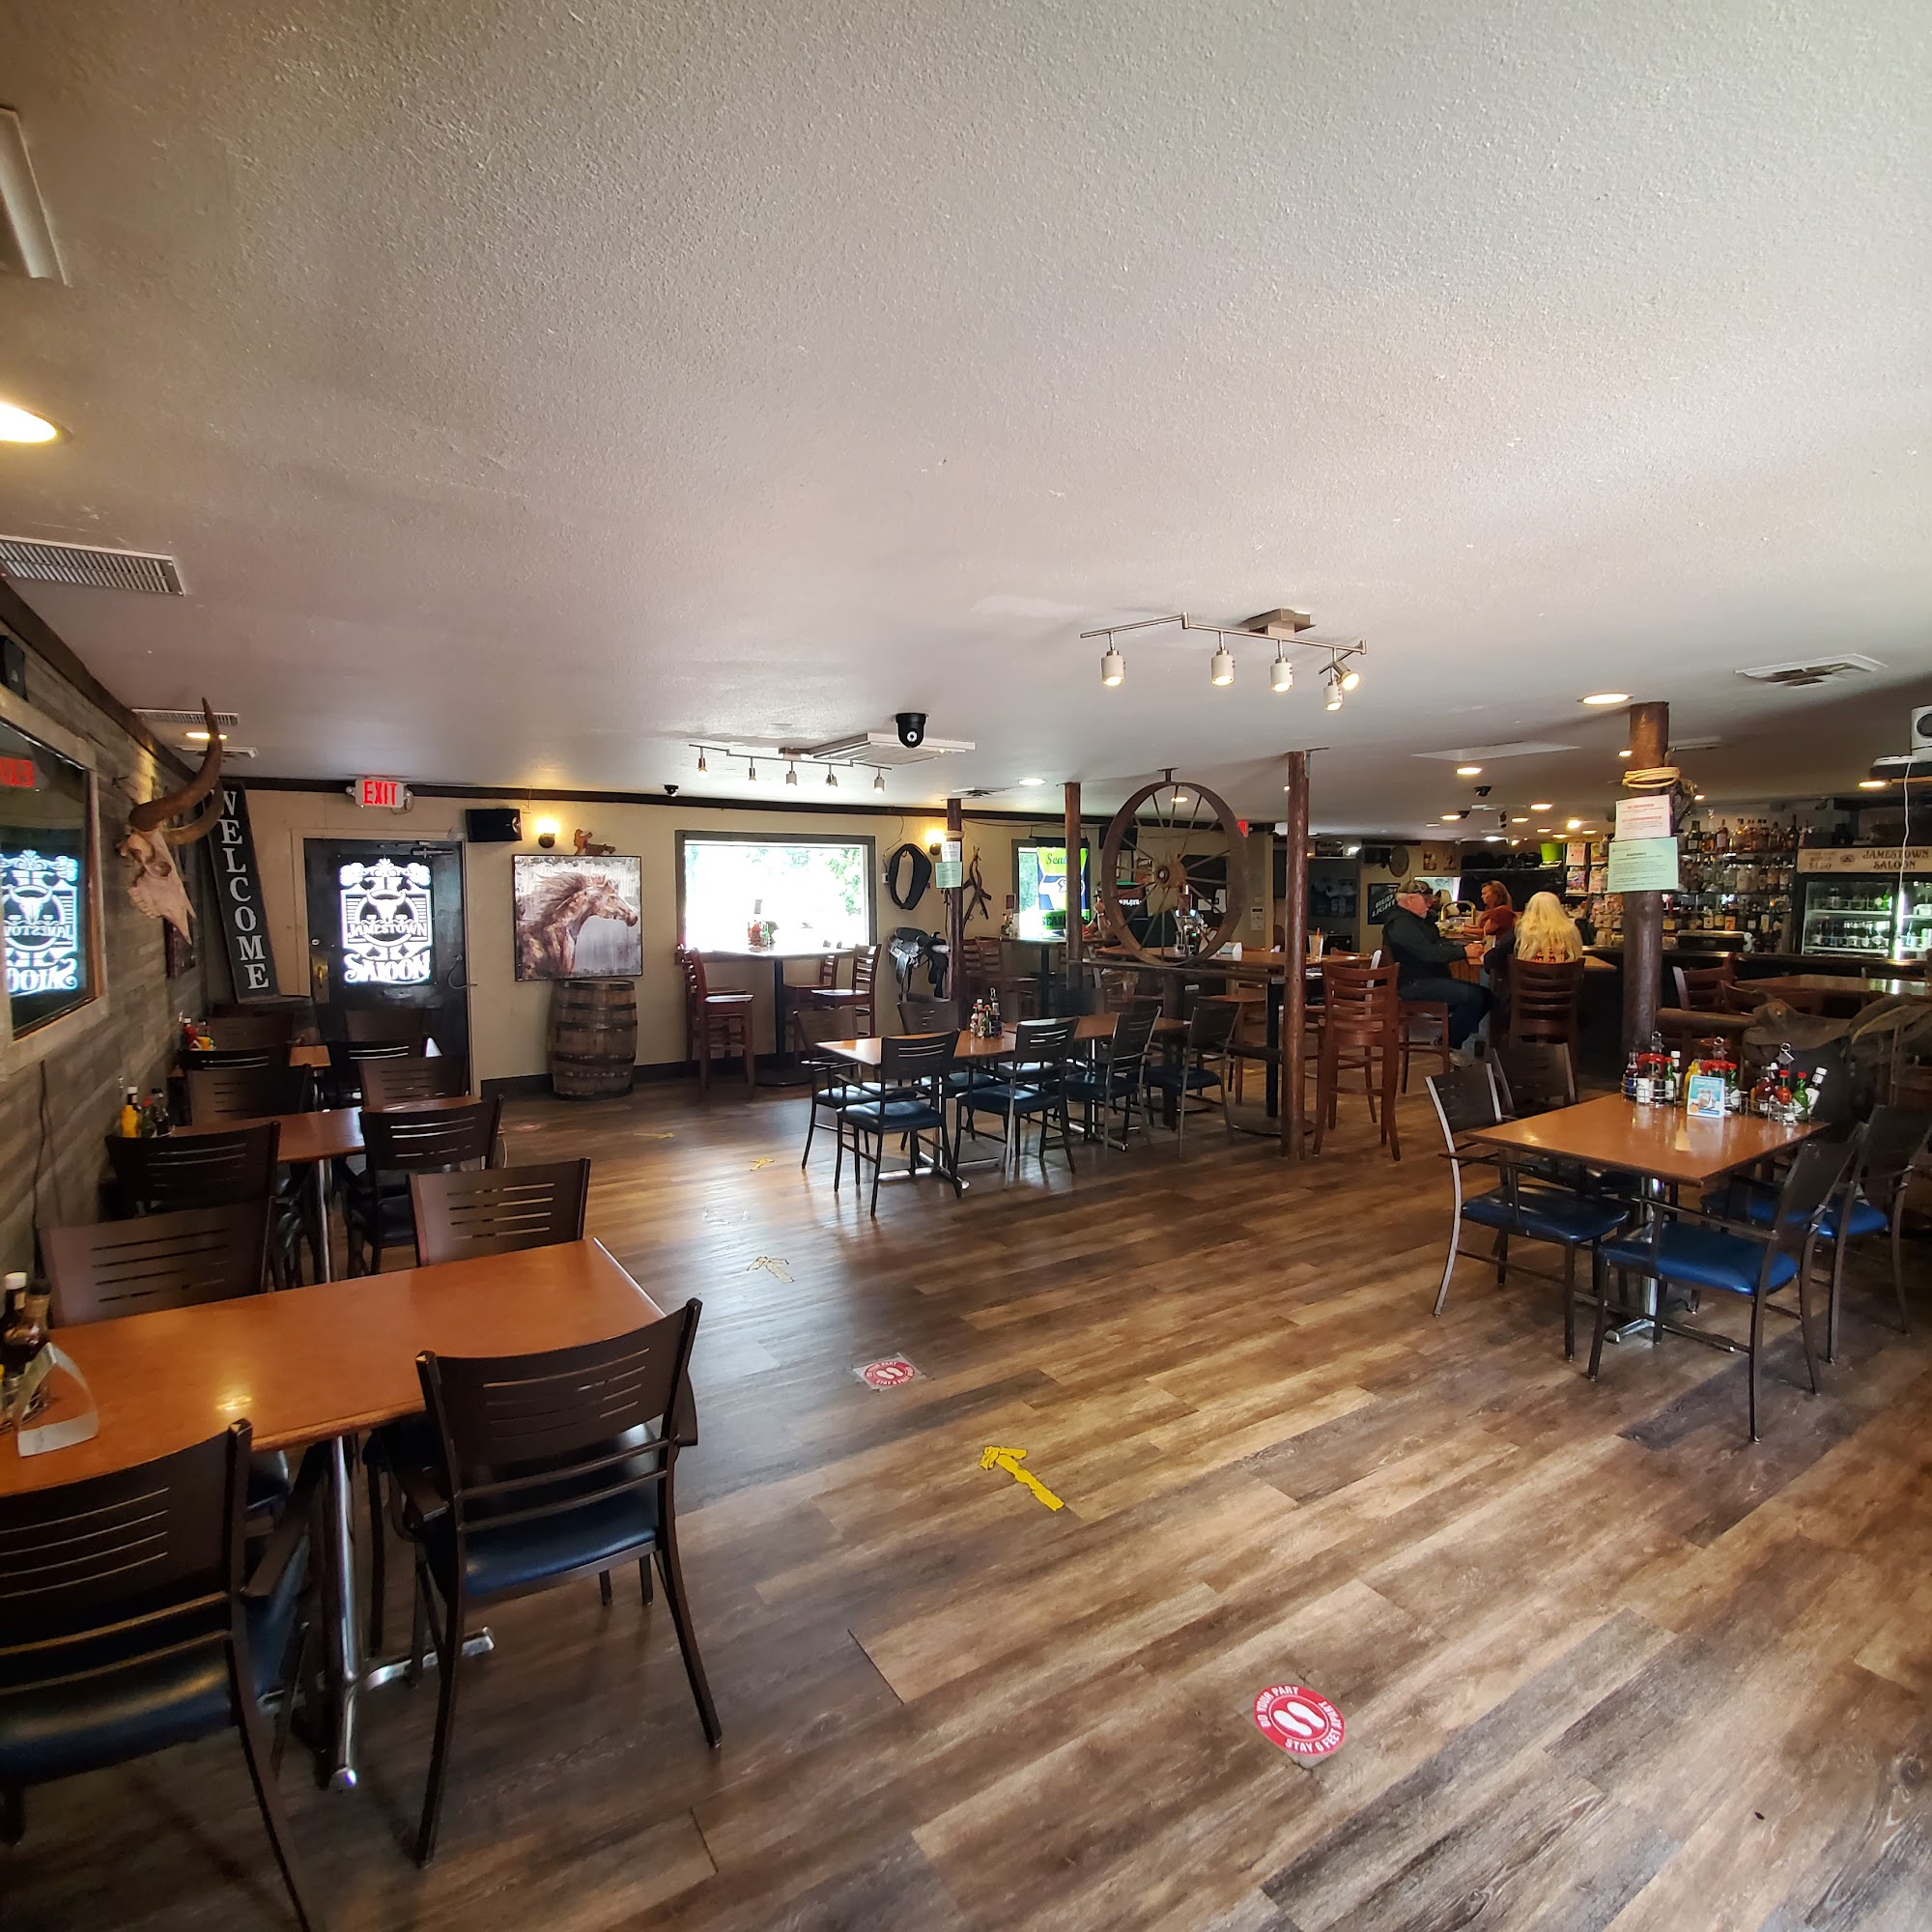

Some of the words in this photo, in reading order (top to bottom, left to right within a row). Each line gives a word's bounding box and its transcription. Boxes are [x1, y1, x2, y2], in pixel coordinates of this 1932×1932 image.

[363, 781, 397, 806] EXIT
[1046, 853, 1066, 866] Sea
[1862, 849, 1929, 860] JAMESTOWN
[1873, 861, 1916, 869] SALOON
[211, 789, 270, 990] WELCOME
[1372, 898, 1396, 918] LIGHT
[1376, 894, 1394, 908] BUD
[348, 922, 427, 937] JAMESTOWN
[344, 951, 431, 983] SALOON
[1271, 1686, 1298, 1696] PART
[1256, 1691, 1274, 1712] YOUR
[1257, 1714, 1271, 1727] DO
[1318, 1701, 1343, 1729] APART
[1285, 1738, 1313, 1752] STAY
[1322, 1728, 1342, 1748] FEET
[1315, 1741, 1323, 1751] 6
